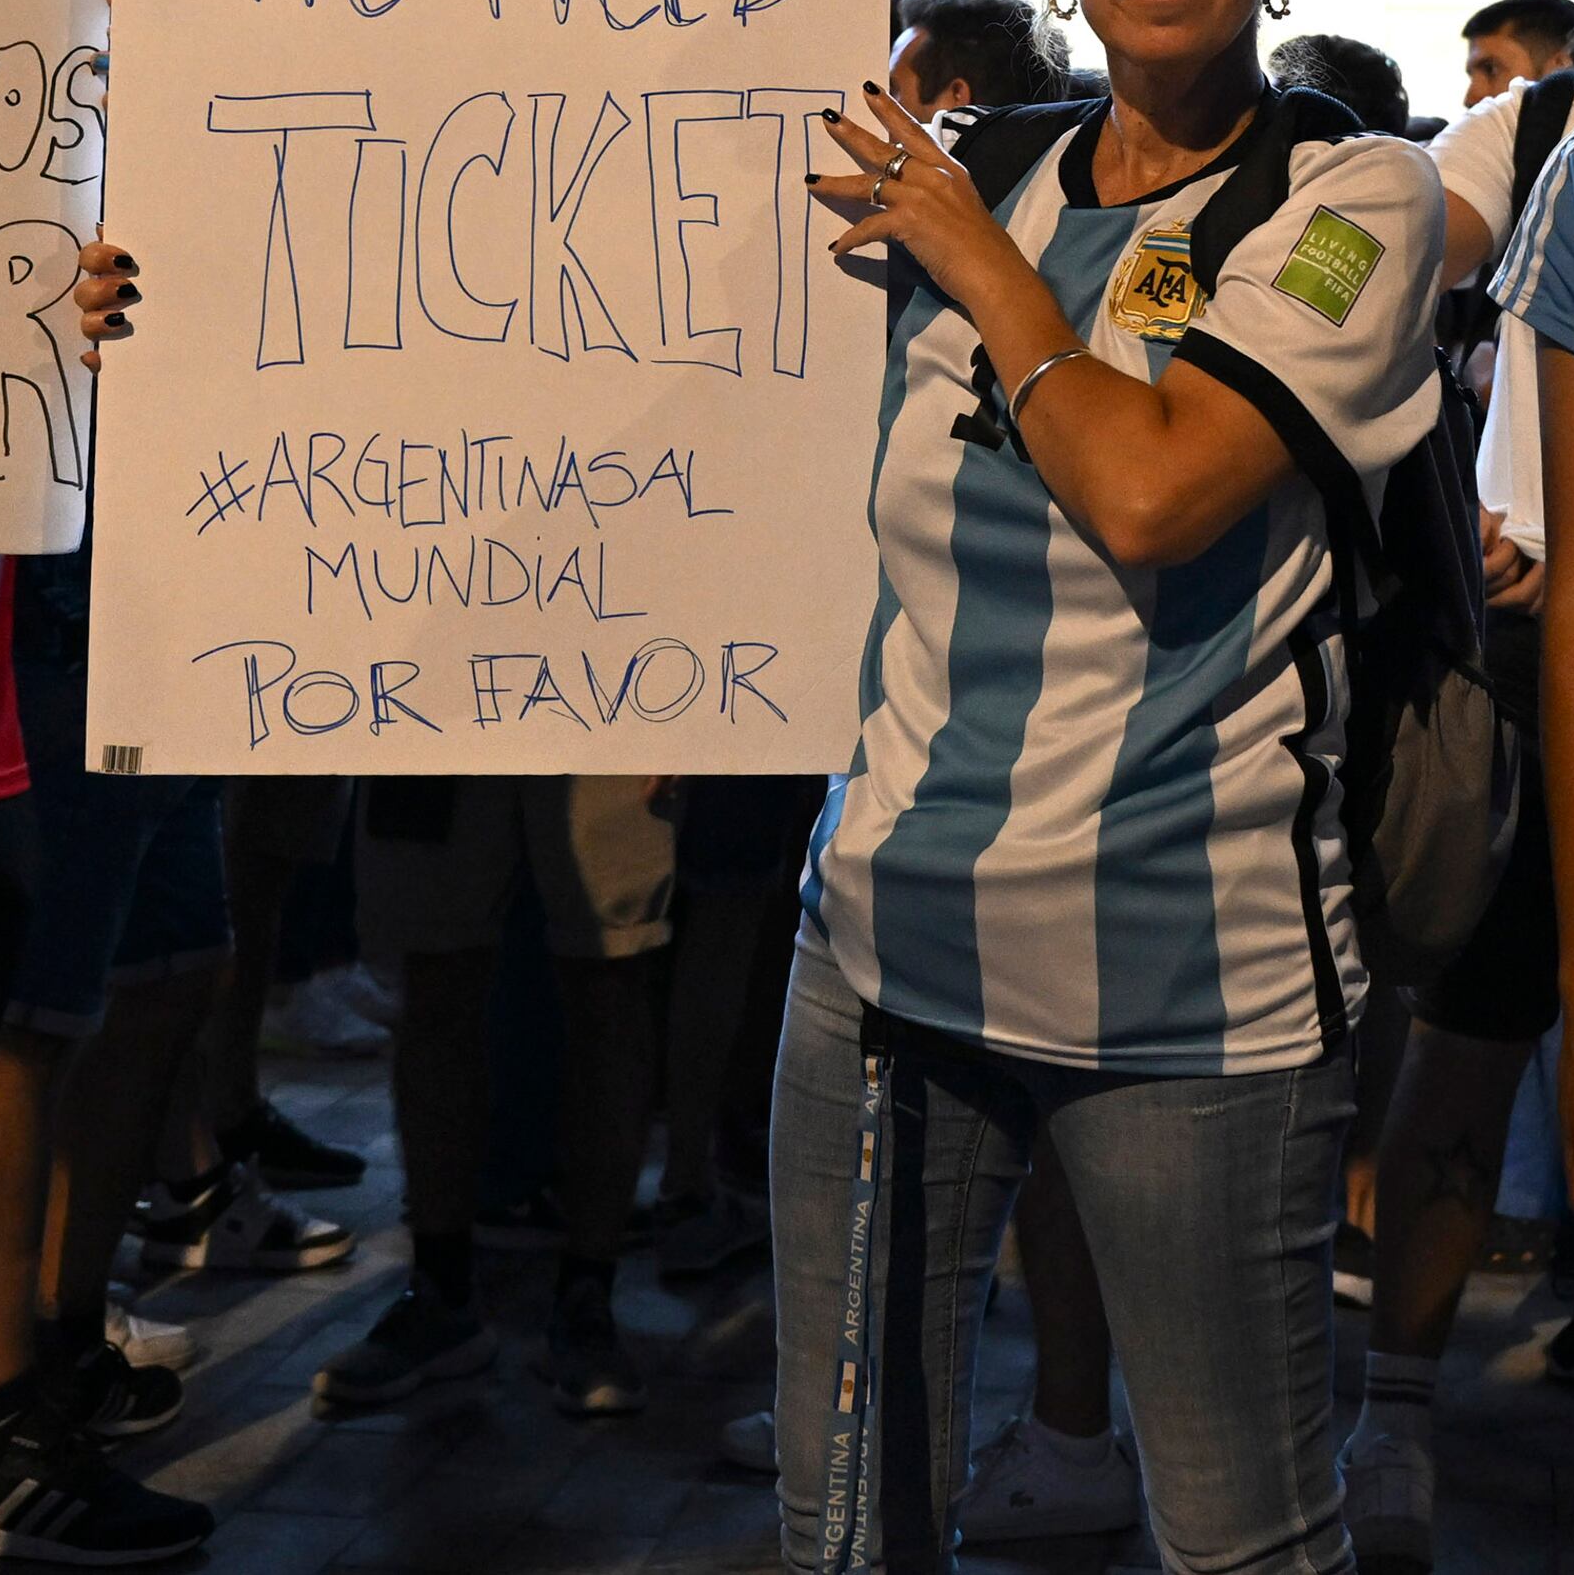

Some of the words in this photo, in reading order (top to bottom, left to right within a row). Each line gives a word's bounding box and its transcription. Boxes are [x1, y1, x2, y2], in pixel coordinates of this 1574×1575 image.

[206, 88, 846, 380] TICKET
[1308, 232, 1368, 272] LIVING
[1133, 256, 1192, 308] AFA
[1300, 243, 1360, 285] FOOTBALL
[1324, 277, 1351, 302] FIFA
[191, 639, 443, 751] POR
[470, 636, 788, 733] FAVOR
[844, 1200, 871, 1347] ARGENTINA
